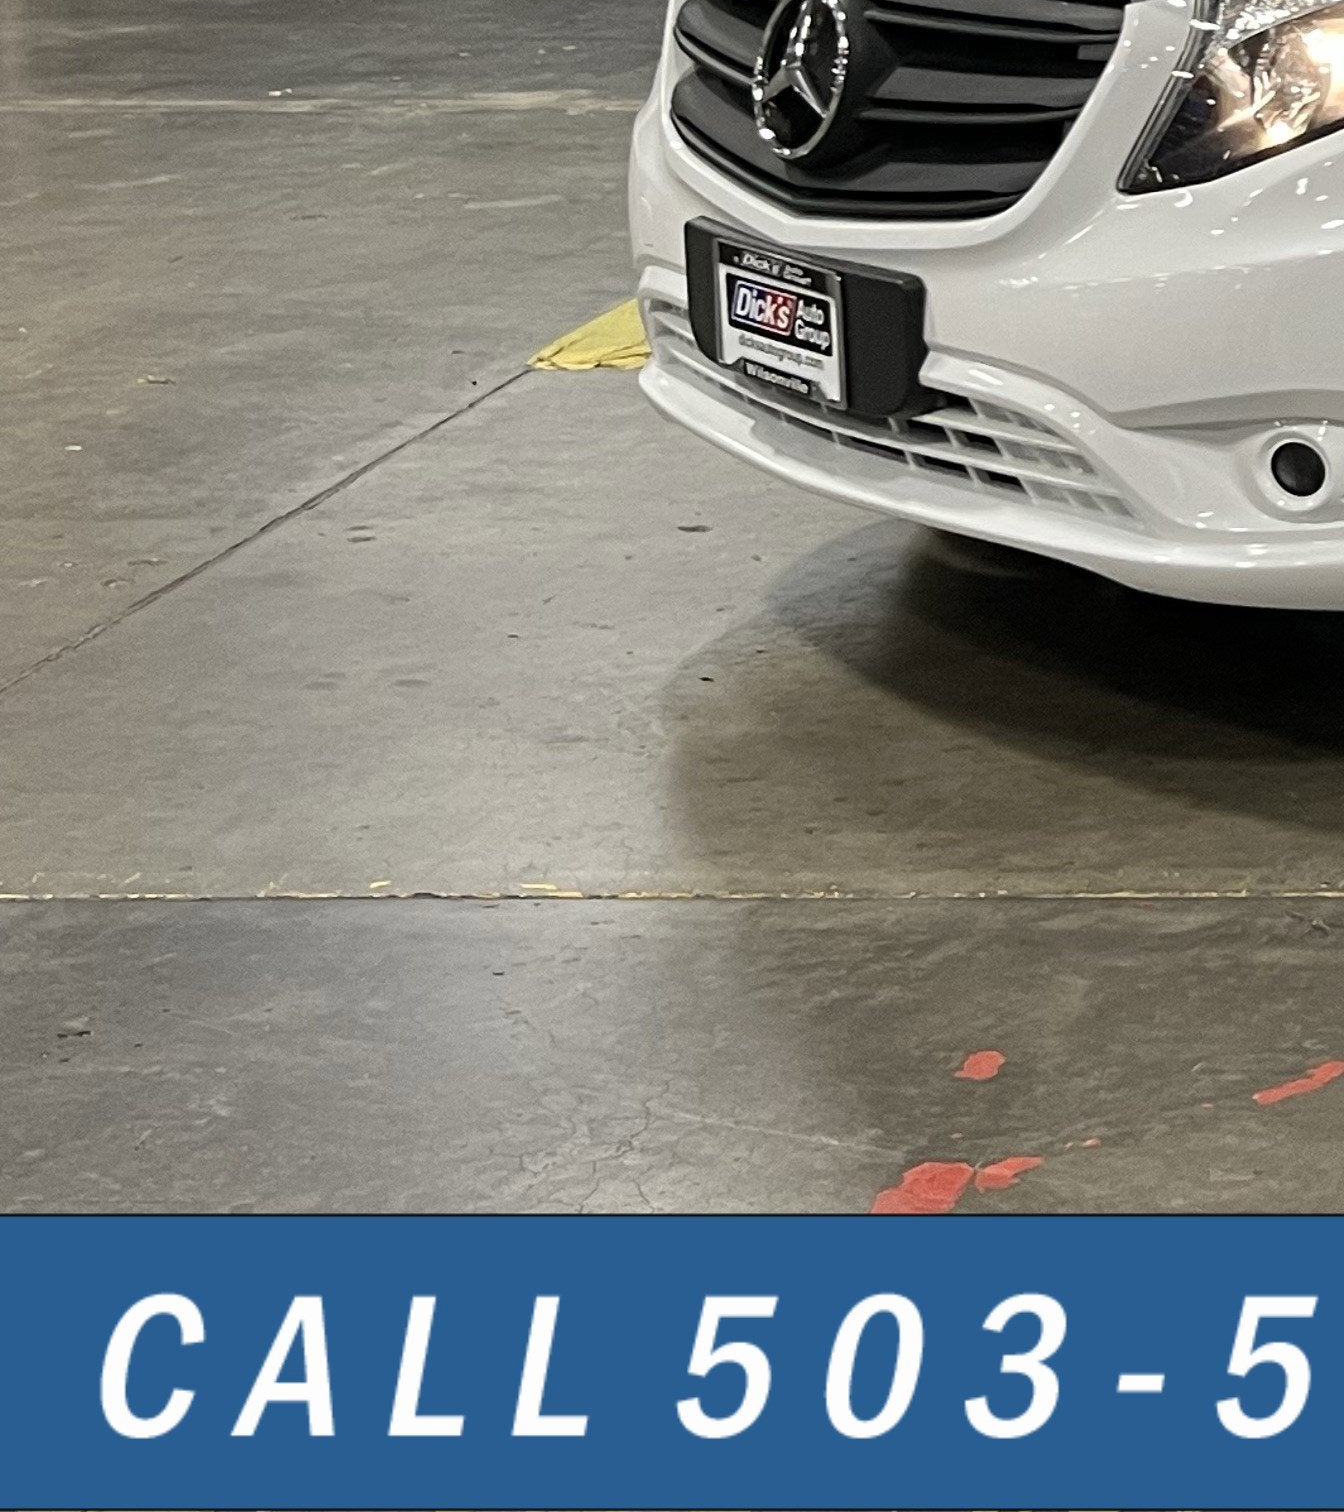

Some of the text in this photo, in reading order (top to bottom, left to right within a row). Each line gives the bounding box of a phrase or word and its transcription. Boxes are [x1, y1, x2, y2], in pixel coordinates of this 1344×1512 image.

[736, 287, 791, 329] Dick's
[796, 299, 825, 326] Auto
[794, 319, 831, 350] Group
